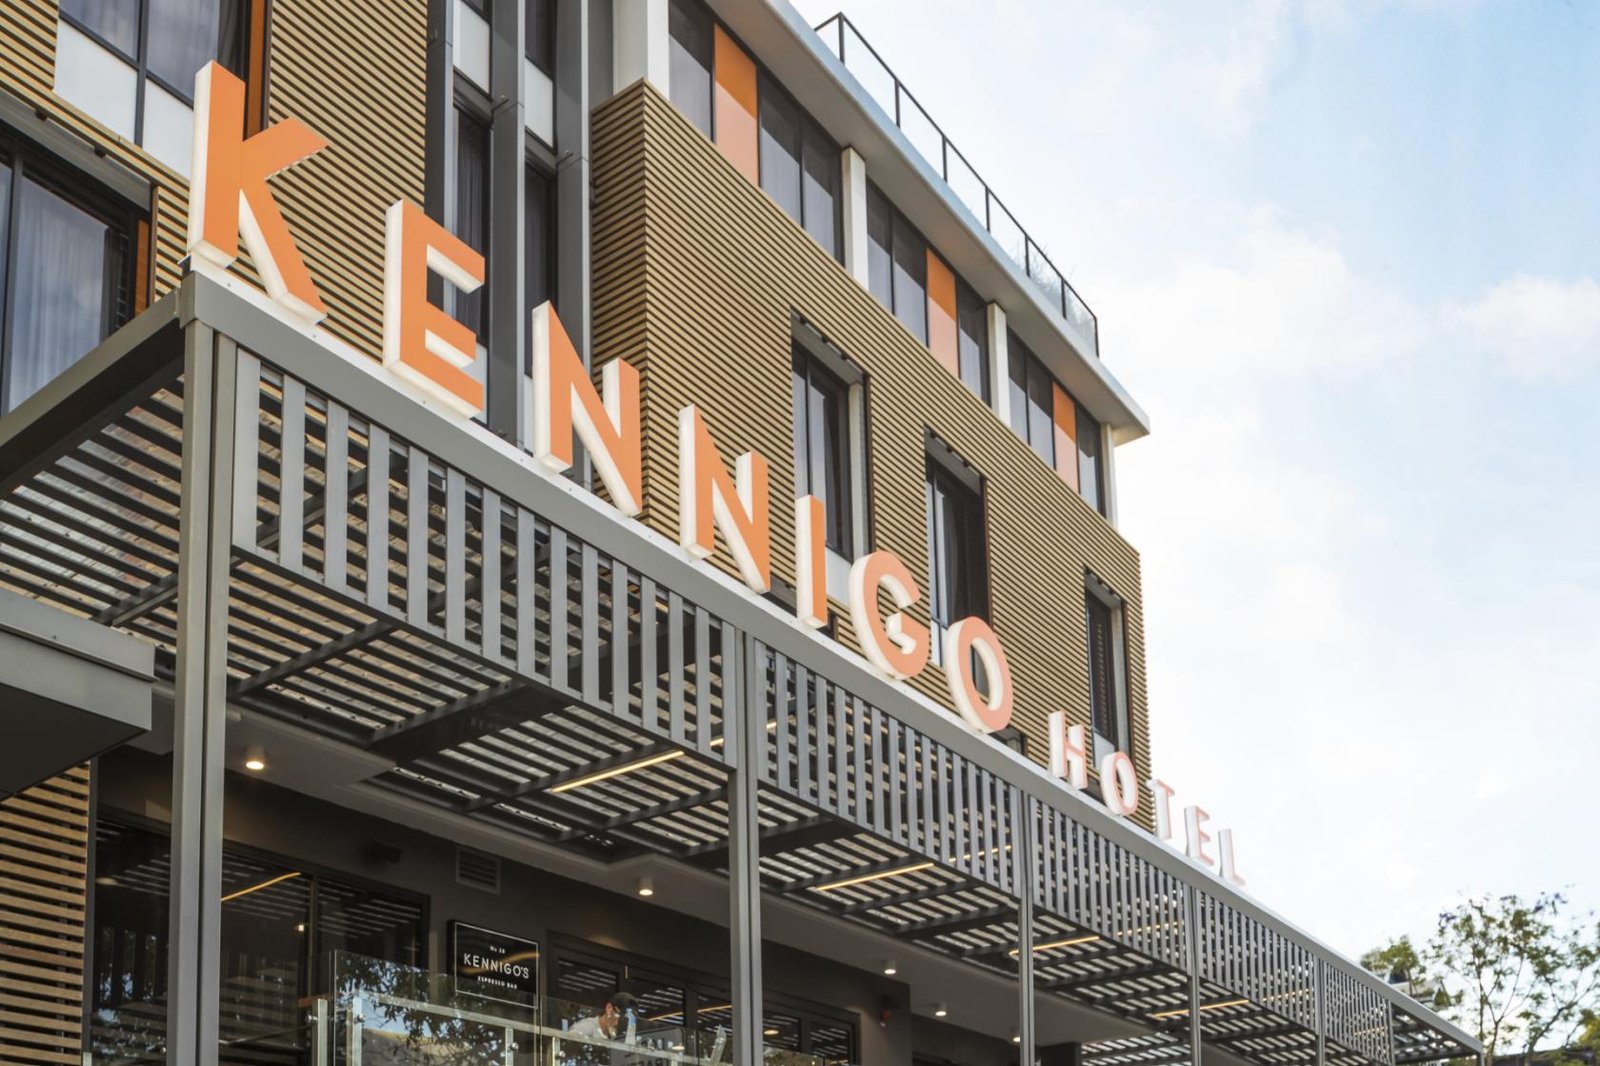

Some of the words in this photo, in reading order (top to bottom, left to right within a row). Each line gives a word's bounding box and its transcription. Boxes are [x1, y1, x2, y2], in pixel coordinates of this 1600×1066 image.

[187, 60, 1013, 734] KENNIGO
[1048, 710, 1245, 886] HOTEL
[463, 953, 529, 979] KENNIGO'S
[477, 976, 505, 987] ESPRESSO
